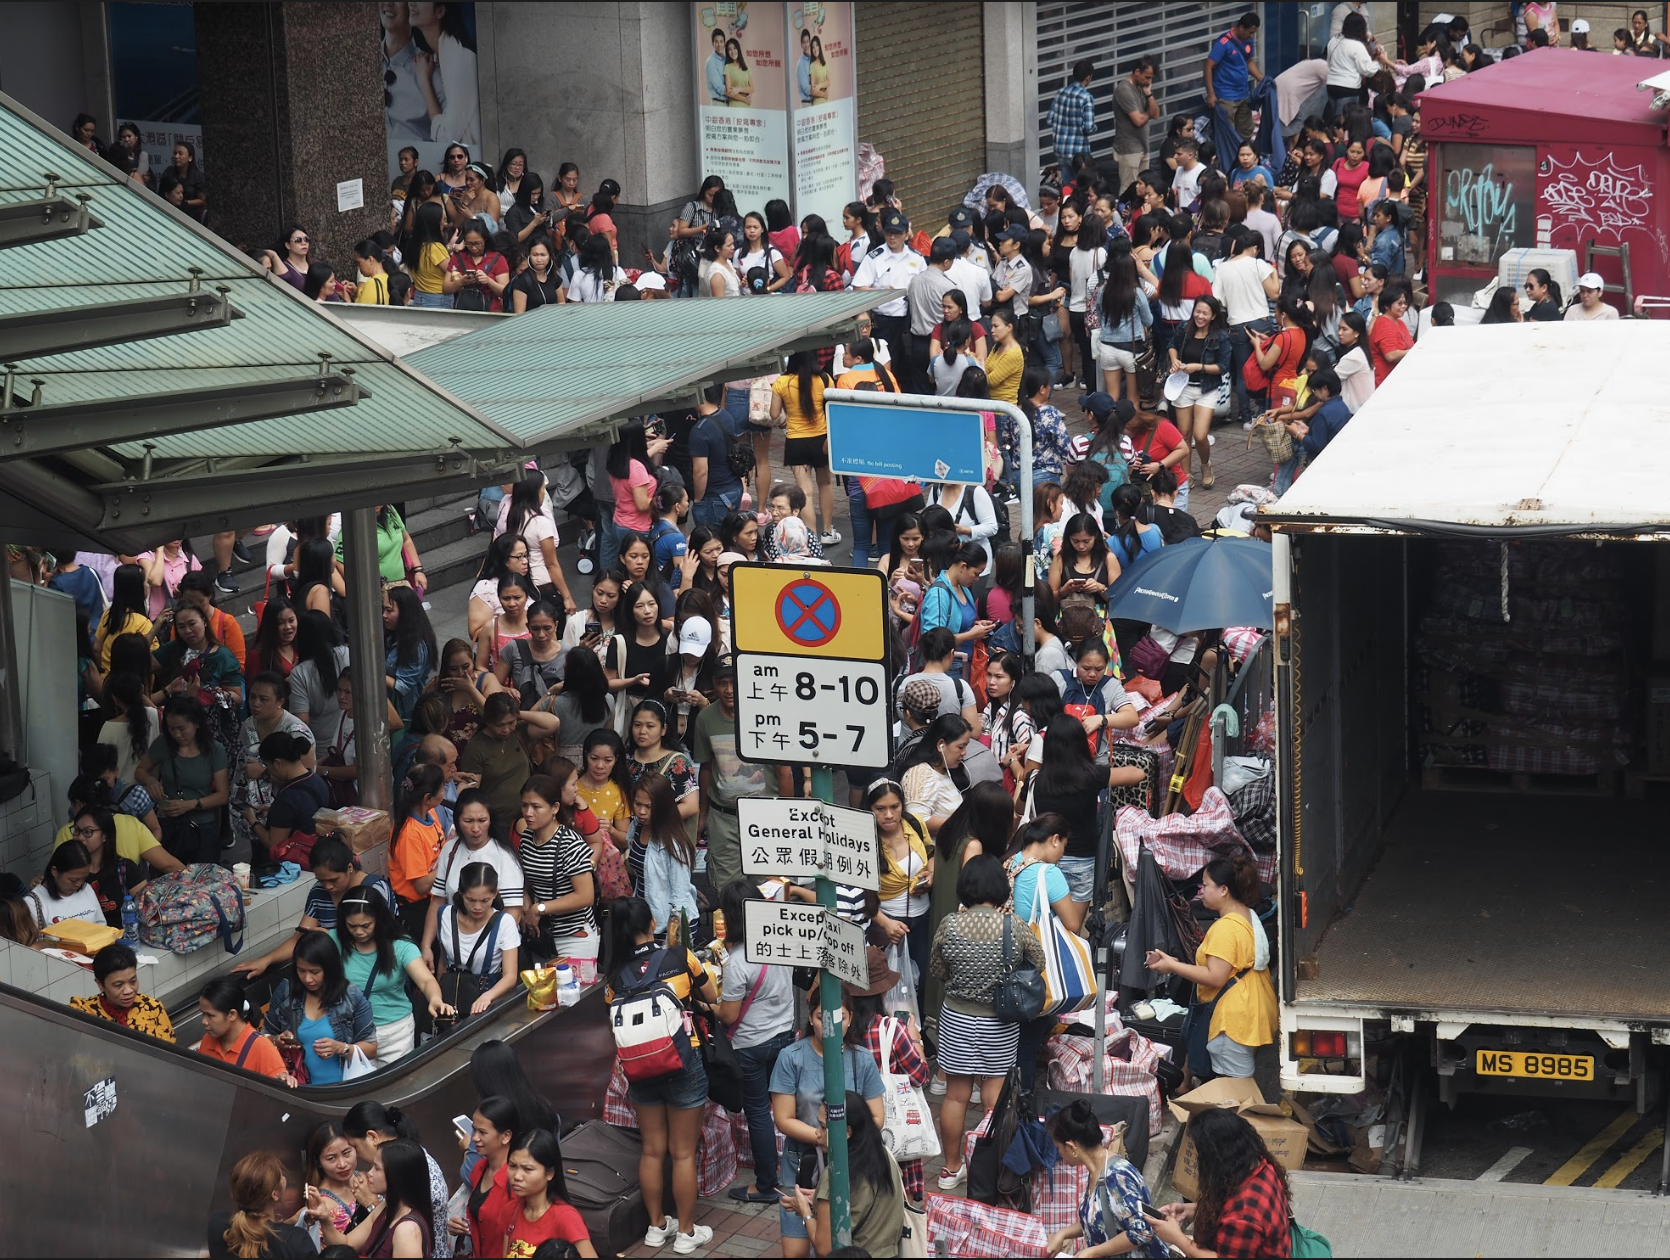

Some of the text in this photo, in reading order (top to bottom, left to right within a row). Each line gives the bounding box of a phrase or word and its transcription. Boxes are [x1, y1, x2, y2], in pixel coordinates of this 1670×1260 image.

[883, 462, 903, 470] posting
[753, 665, 779, 677] am
[746, 681, 788, 702] 上午
[795, 671, 879, 705] 8-10
[755, 714, 781, 728] pm
[748, 731, 790, 751] 下午
[798, 721, 866, 753] 5-7
[748, 823, 813, 840] General
[763, 923, 794, 937] pick
[841, 942, 855, 956] off
[658, 968, 680, 978] PACIFIC
[1482, 1053, 1589, 1077] MS 8985
